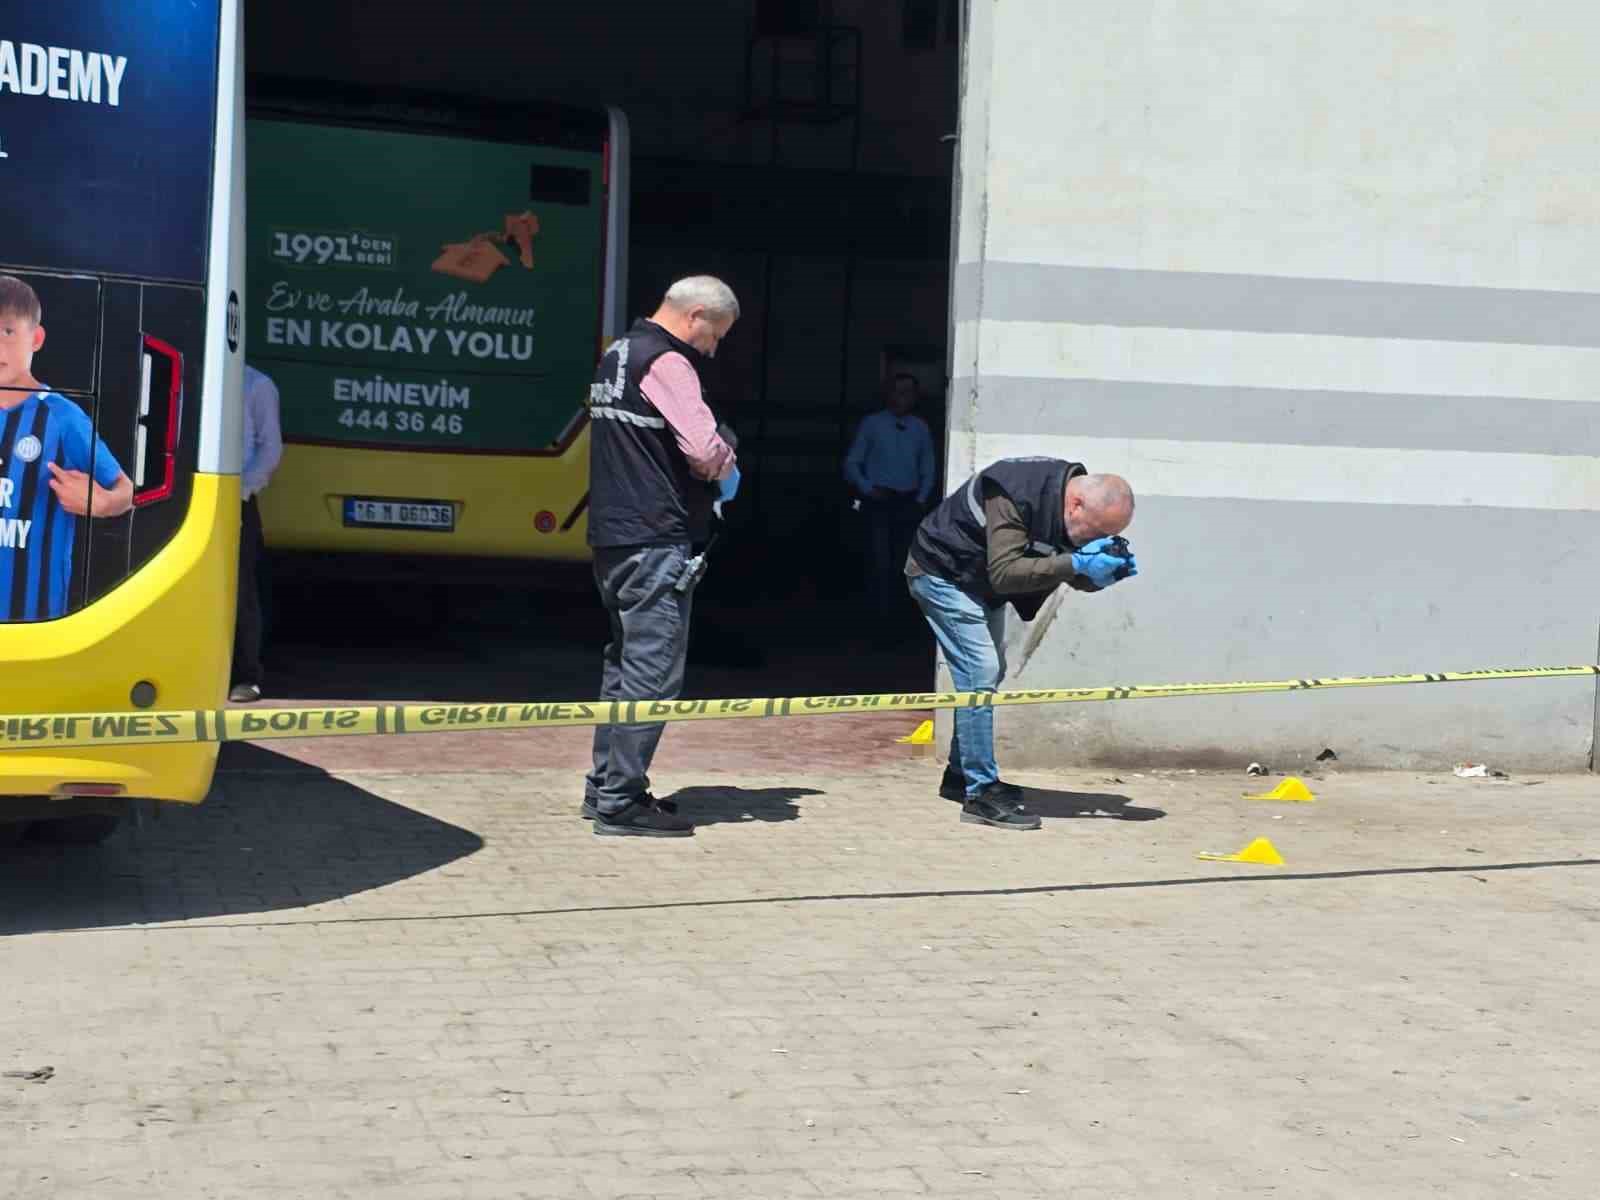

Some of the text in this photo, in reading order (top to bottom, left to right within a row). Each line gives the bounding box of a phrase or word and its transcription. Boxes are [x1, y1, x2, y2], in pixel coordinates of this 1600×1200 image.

[0, 40, 127, 106] ADEMY
[266, 281, 534, 327] Ev ve Araba Almanın
[266, 317, 311, 346] EN
[320, 320, 437, 354] KOLAY
[445, 330, 533, 360] YOLU
[333, 375, 470, 409] EMİNEVİM
[338, 408, 463, 434] 444 36 46
